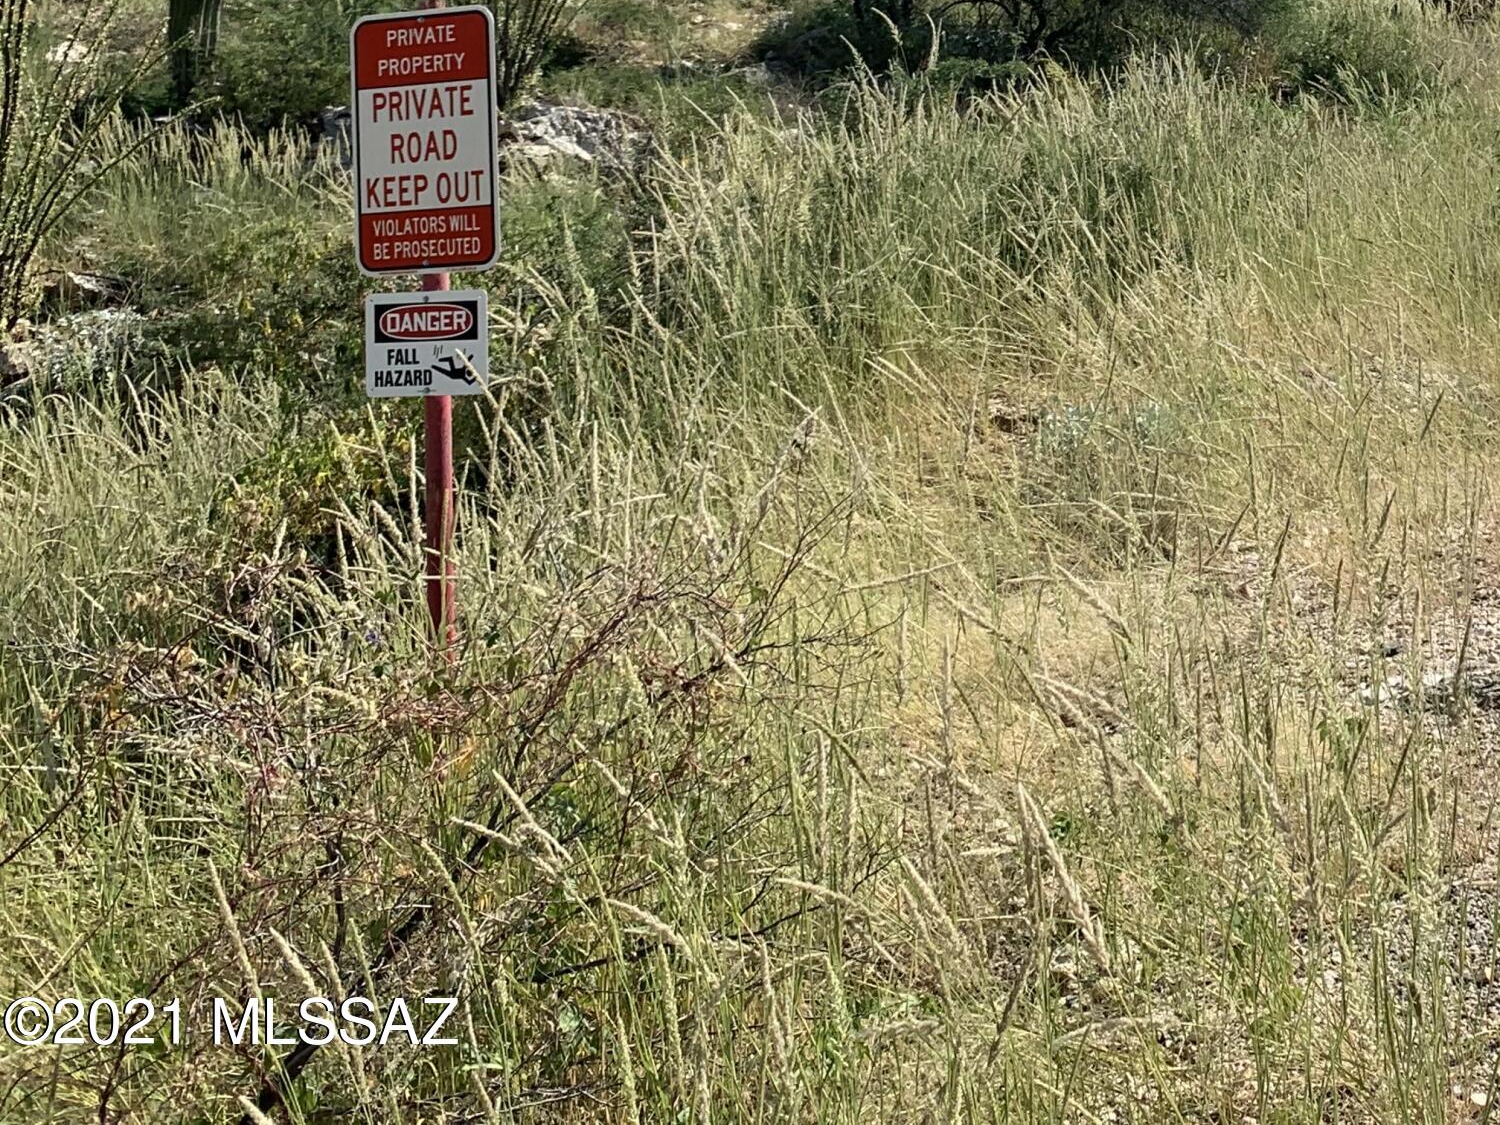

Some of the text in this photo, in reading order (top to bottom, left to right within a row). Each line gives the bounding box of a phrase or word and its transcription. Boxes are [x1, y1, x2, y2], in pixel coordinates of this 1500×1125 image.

[386, 25, 456, 48] PRIVATE
[378, 52, 465, 77] PROPERTY
[372, 85, 475, 123] PRIVATE
[390, 130, 458, 164] ROAD
[366, 170, 485, 209] KEEP OUT
[372, 214, 481, 237] VIOLATORS WILL
[373, 237, 481, 260] BE PROSECUTED
[386, 311, 467, 333] DANGER
[387, 348, 420, 366] FALL
[374, 369, 433, 388] HAZARD
